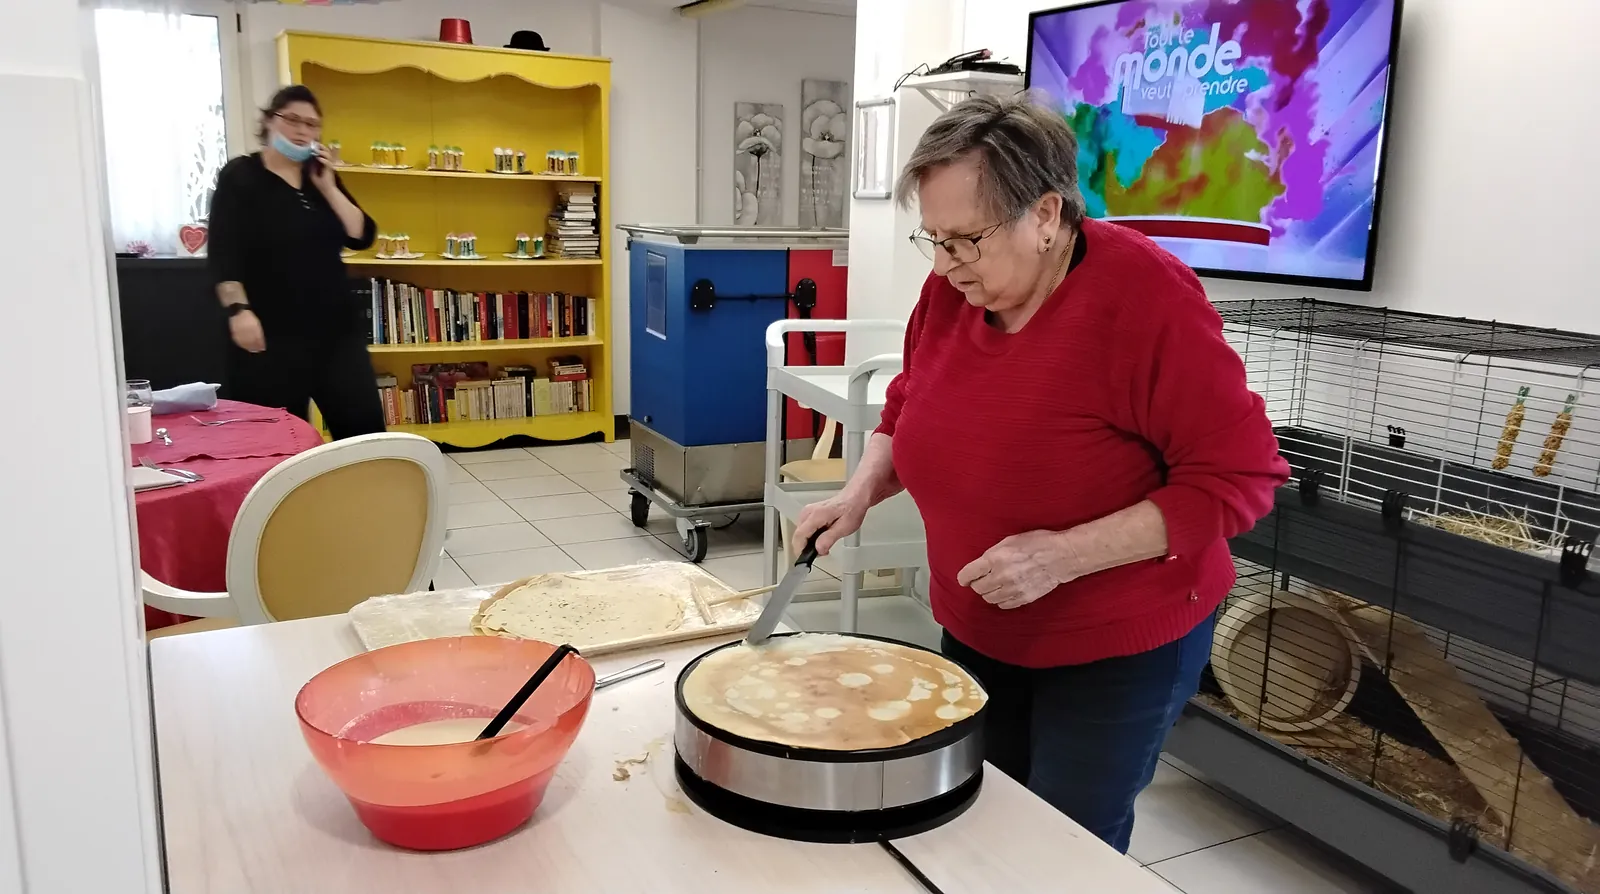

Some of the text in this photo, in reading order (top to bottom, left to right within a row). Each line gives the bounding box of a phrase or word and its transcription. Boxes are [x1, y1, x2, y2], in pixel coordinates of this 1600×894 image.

[1179, 28, 1195, 45] le
[1114, 22, 1242, 89] monde
[1141, 82, 1173, 100] veut
